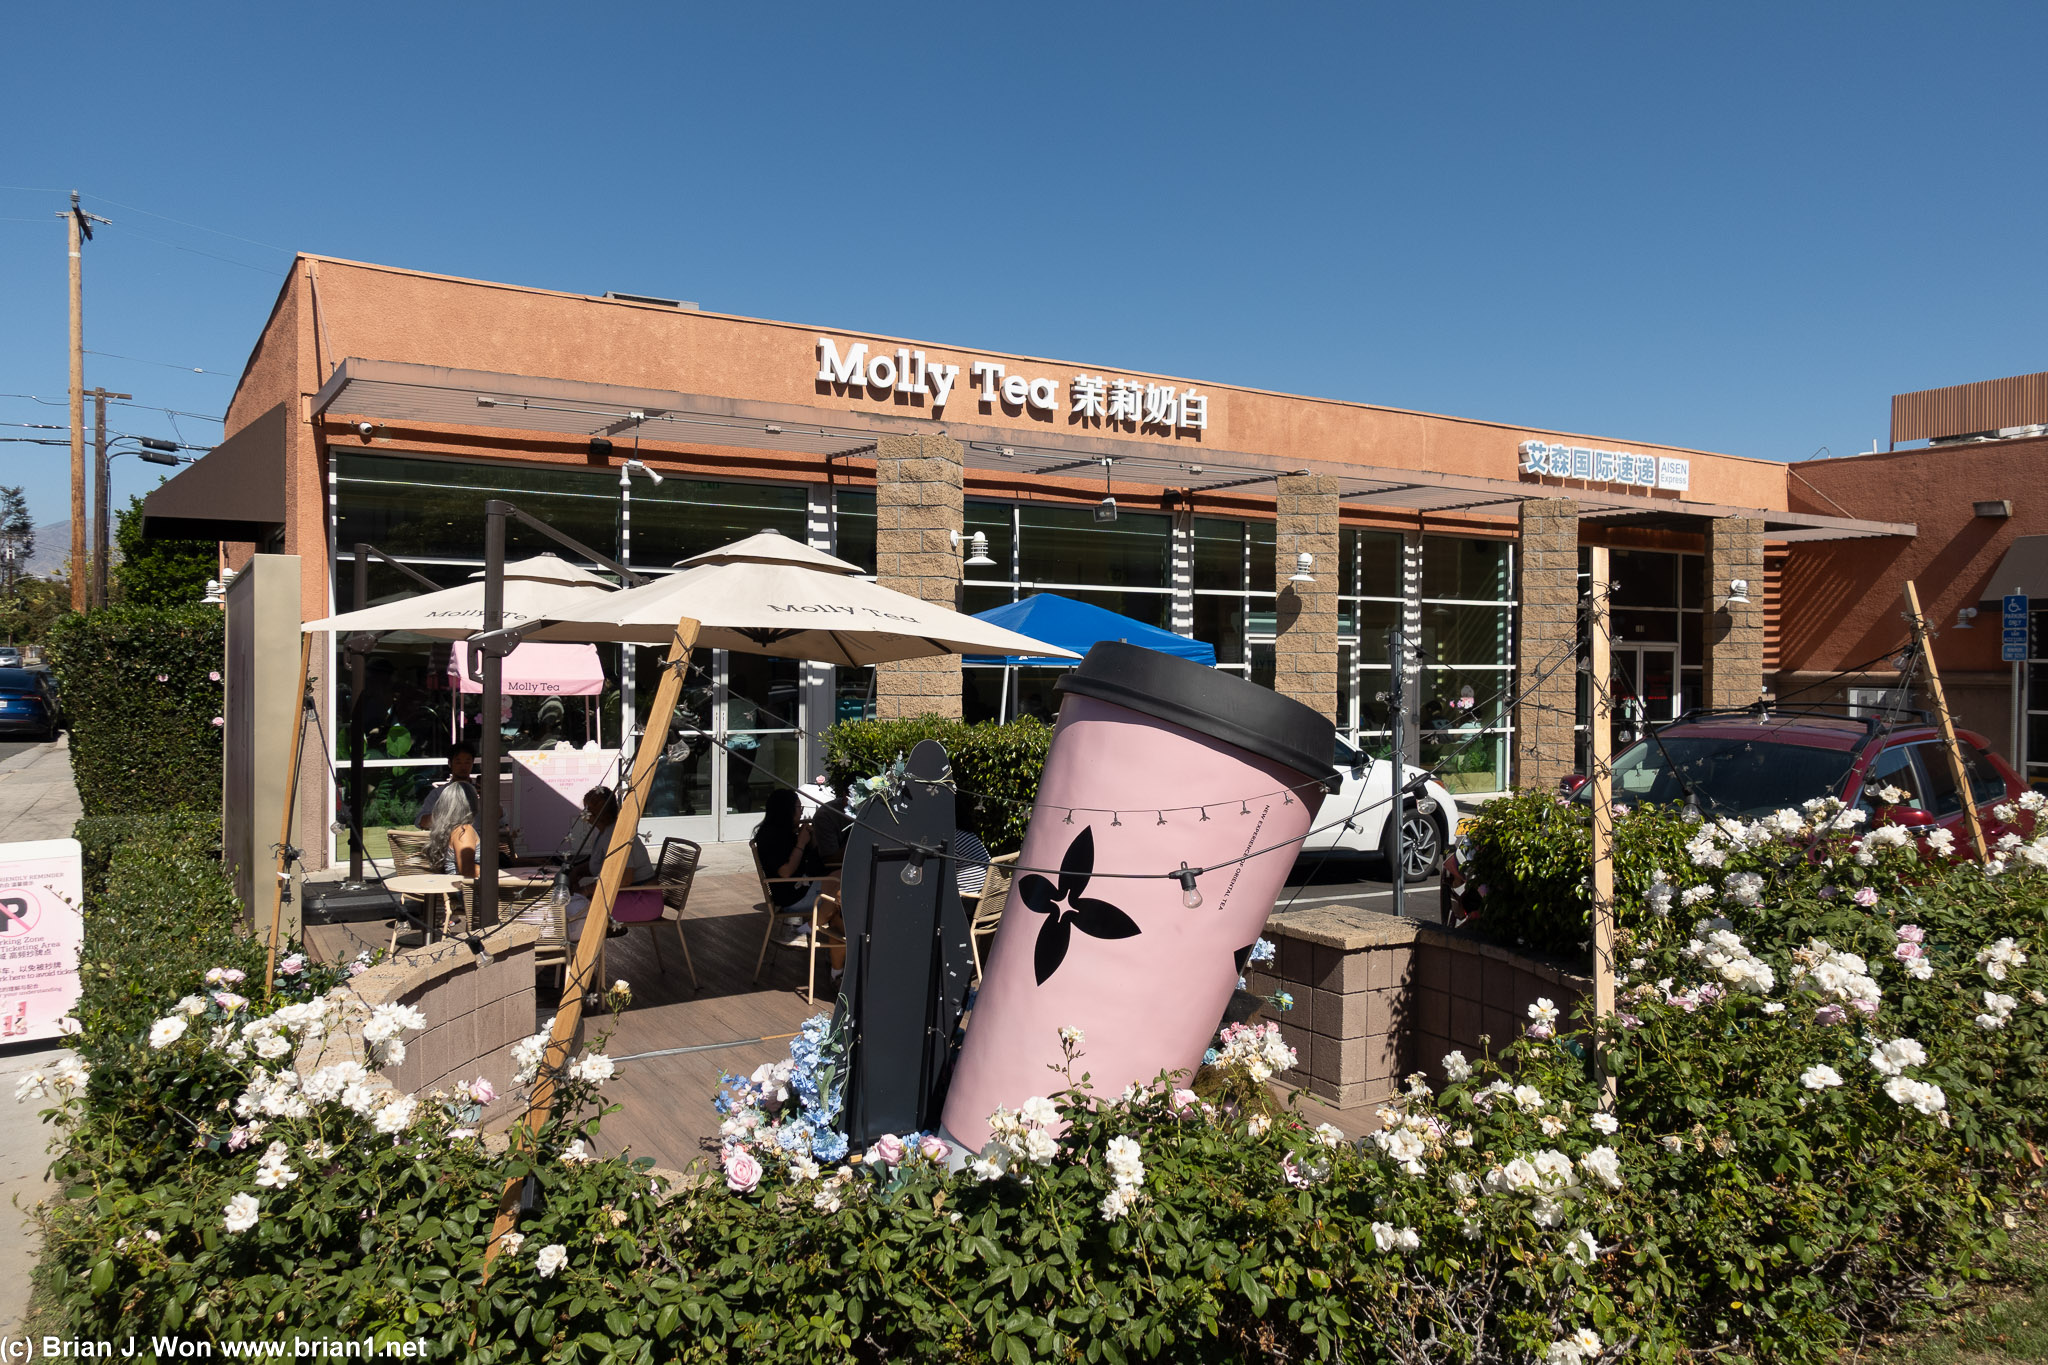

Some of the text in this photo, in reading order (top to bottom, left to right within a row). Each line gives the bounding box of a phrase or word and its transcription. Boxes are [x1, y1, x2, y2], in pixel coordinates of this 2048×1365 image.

[816, 337, 1059, 410] Molly Tea
[1071, 373, 1209, 430] 茉莉奶白
[1527, 443, 1655, 484] 艾森国际速递
[1661, 462, 1687, 475] AISEN
[1661, 474, 1687, 485] Express
[503, 611, 527, 620] Te
[767, 604, 921, 624] Molly Tea
[508, 682, 560, 692] Molly Tea
[1218, 805, 1270, 911] NEW EXPERIENCE OF ORIENTAL TEA
[1, 944, 39, 952] Ticketing
[35, 970, 56, 978] avoid
